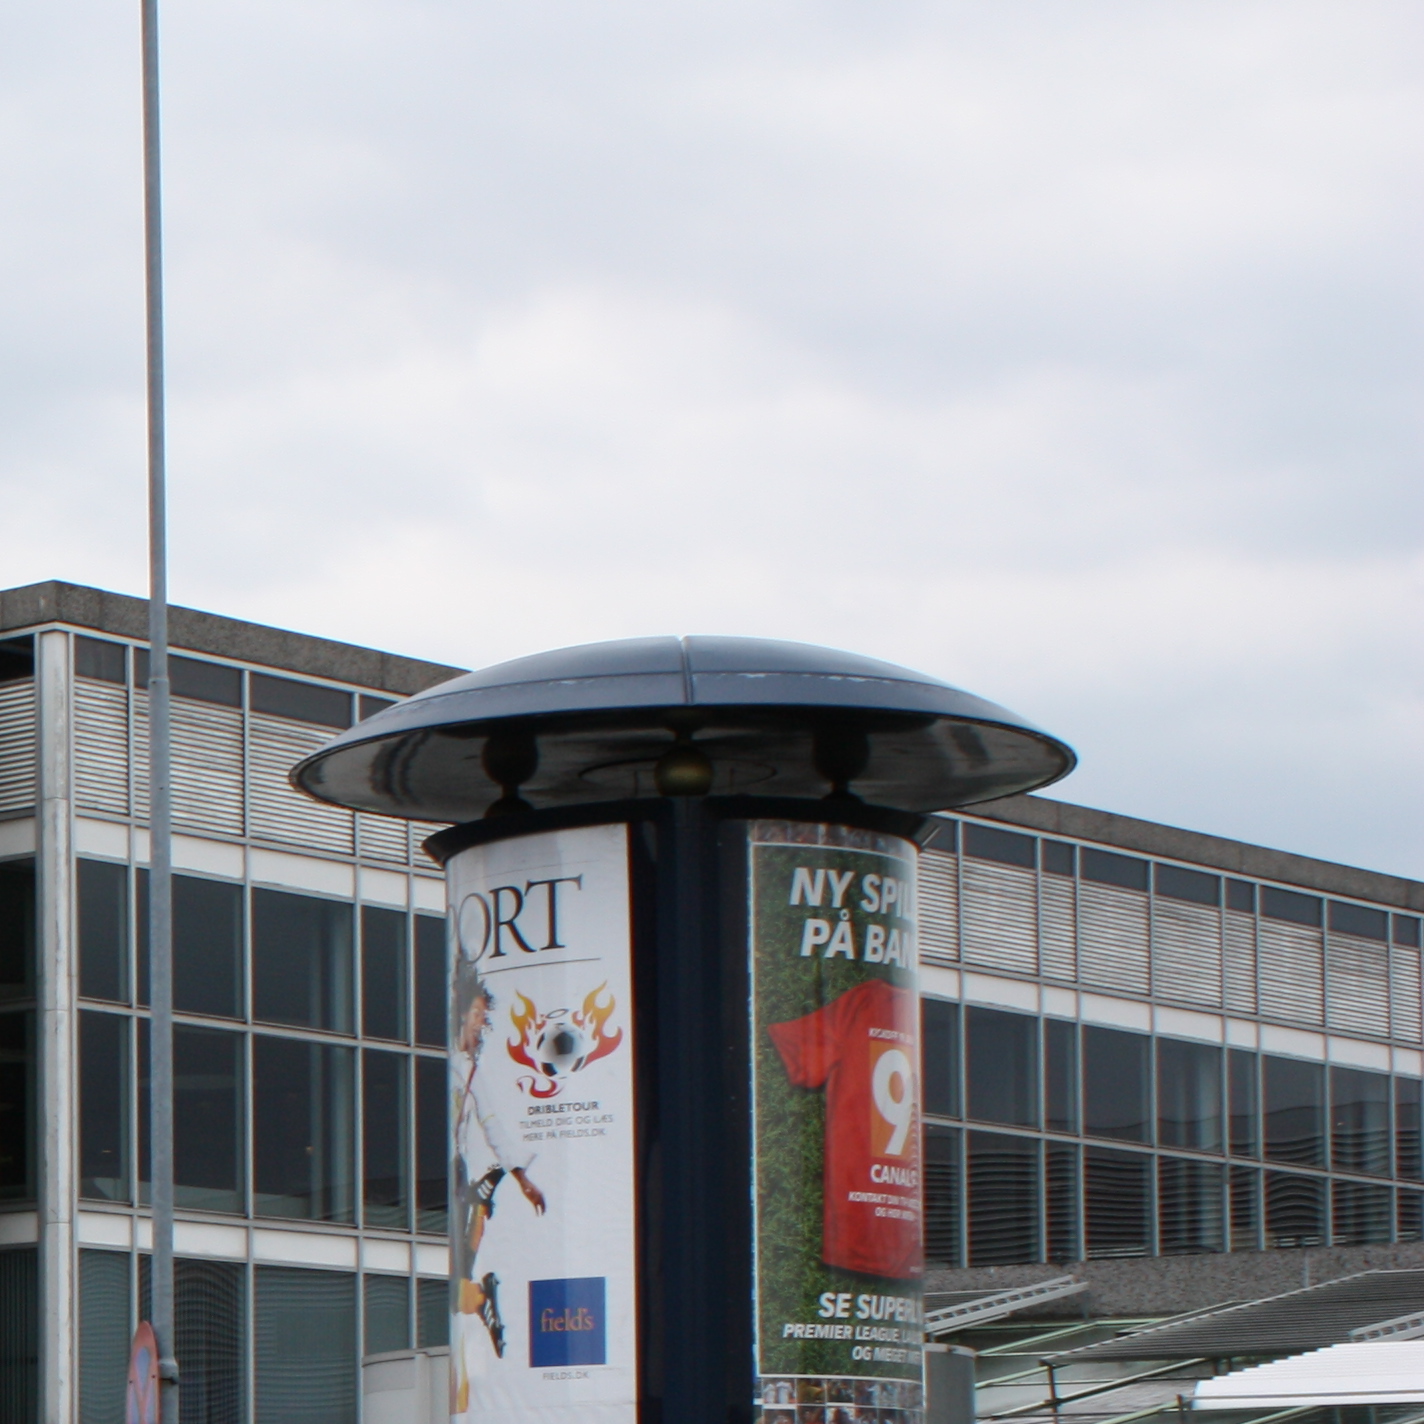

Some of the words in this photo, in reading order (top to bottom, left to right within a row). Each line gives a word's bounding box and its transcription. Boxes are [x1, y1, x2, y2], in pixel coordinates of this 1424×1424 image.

[789, 867, 856, 908] NY
[449, 874, 583, 964] ORT
[800, 908, 856, 960] PÅ
[527, 1101, 599, 1116] DRIBLETOUR
[872, 1049, 913, 1155] 9
[556, 1117, 572, 1126] DIG
[575, 1116, 591, 1125] OG
[593, 1114, 613, 1124] LÆS
[818, 1292, 852, 1318] SE
[541, 1307, 595, 1332] field's
[782, 1323, 852, 1340] PREMIER
[853, 1346, 872, 1360] OG
